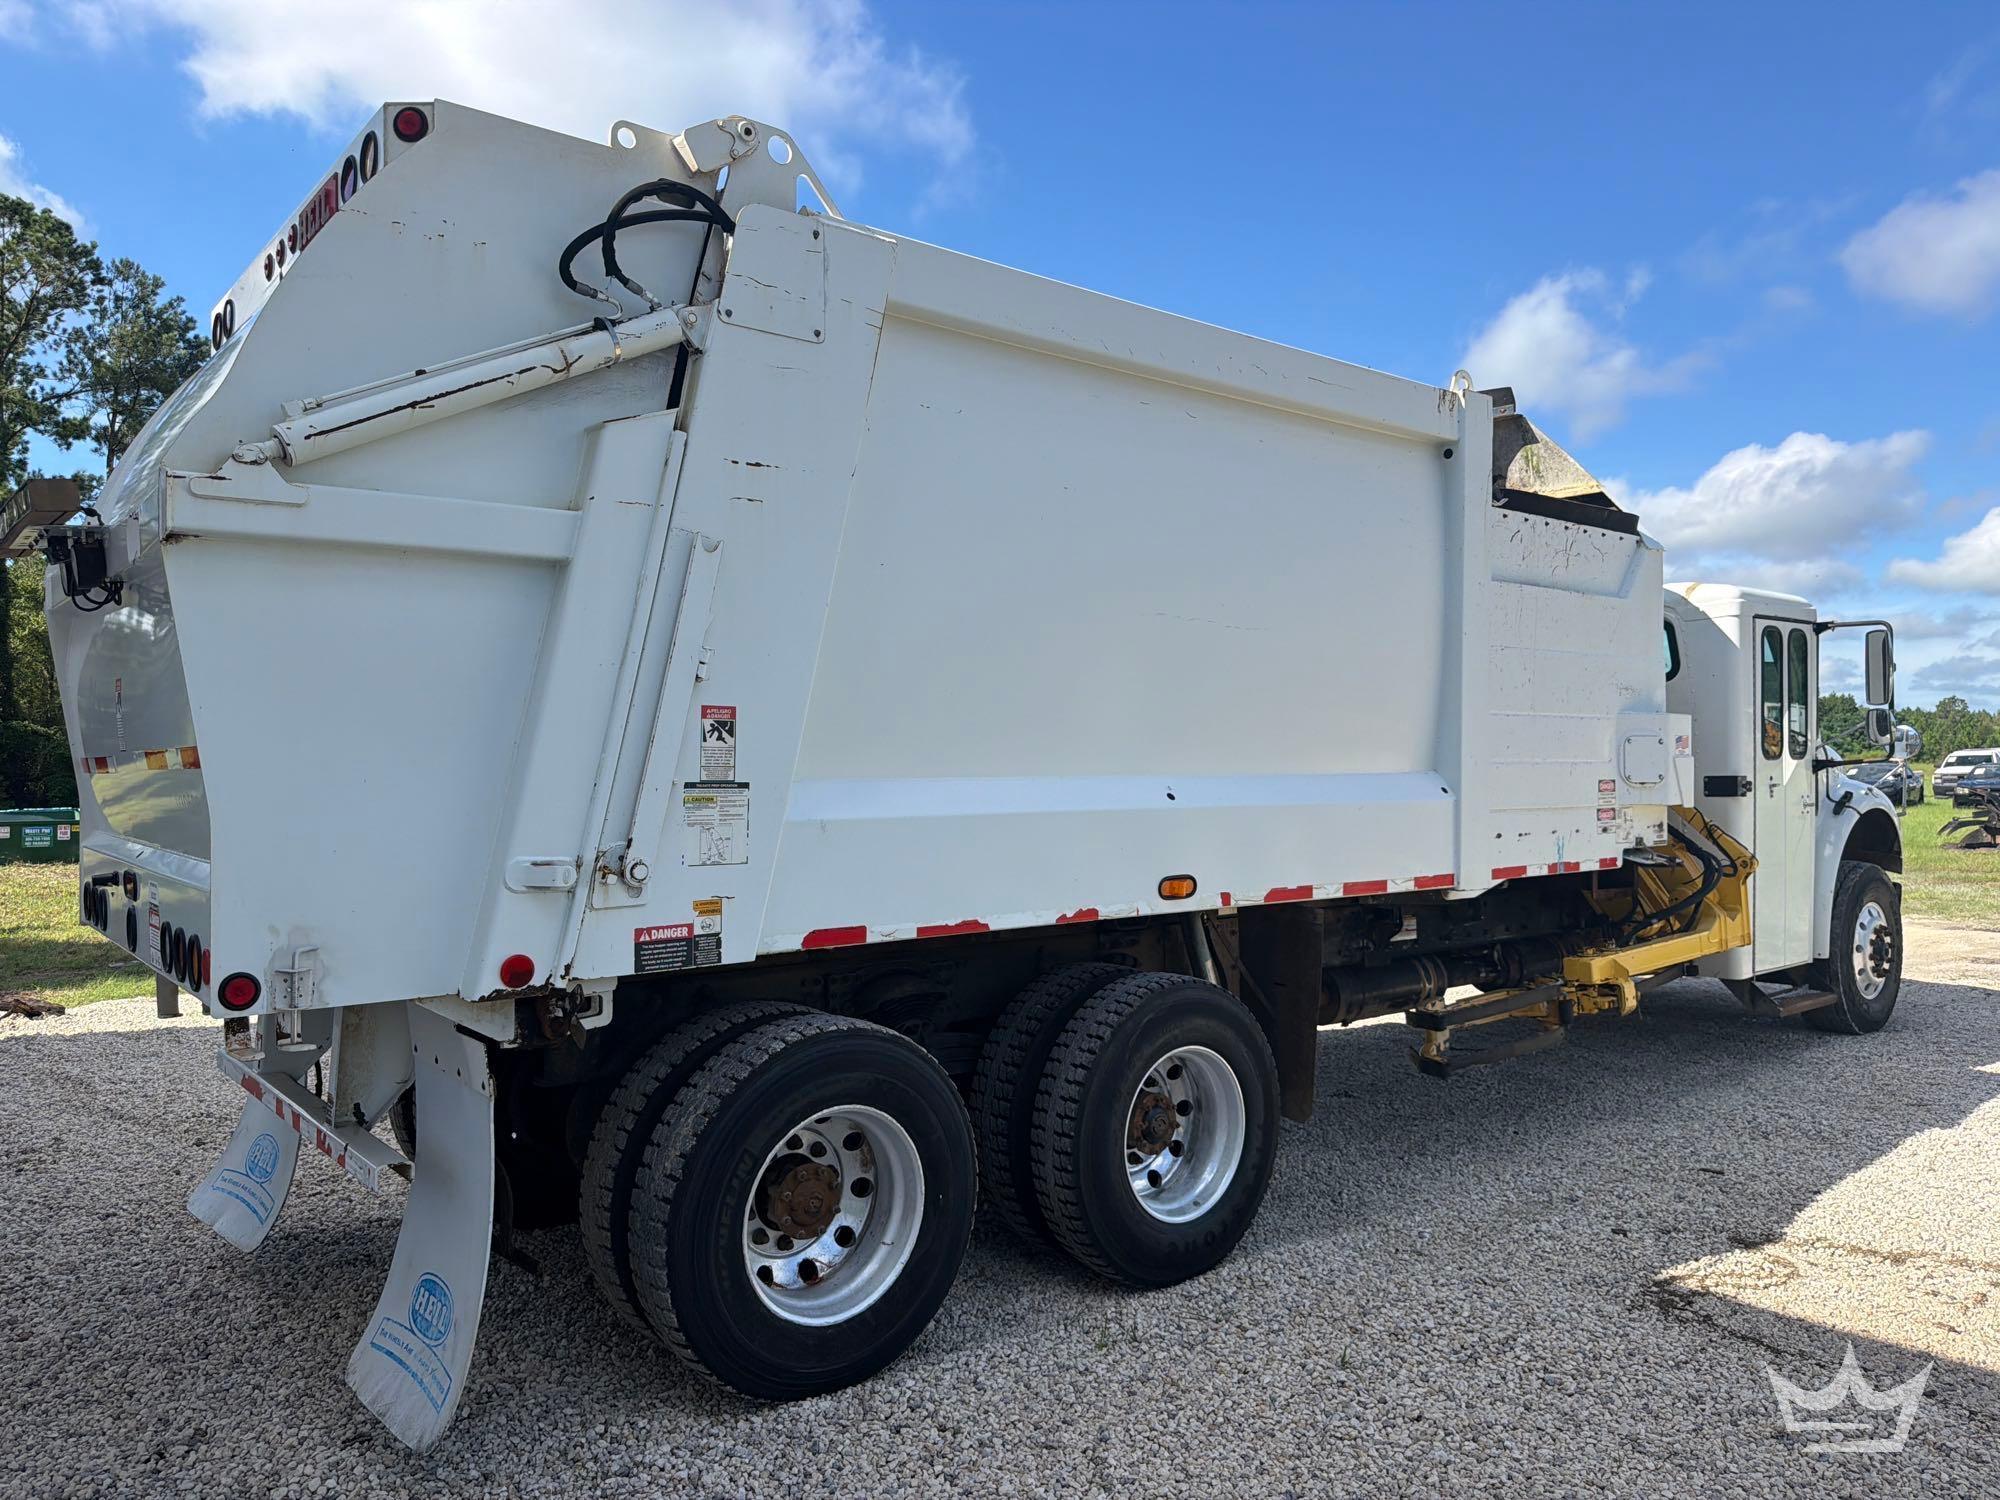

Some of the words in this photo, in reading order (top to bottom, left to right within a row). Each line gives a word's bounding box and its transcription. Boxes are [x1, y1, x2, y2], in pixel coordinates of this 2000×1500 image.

[299, 187, 330, 248] HEIL
[651, 927, 688, 940] DANGER
[249, 1143, 274, 1173] HEIL
[415, 1286, 449, 1335] HEIL
